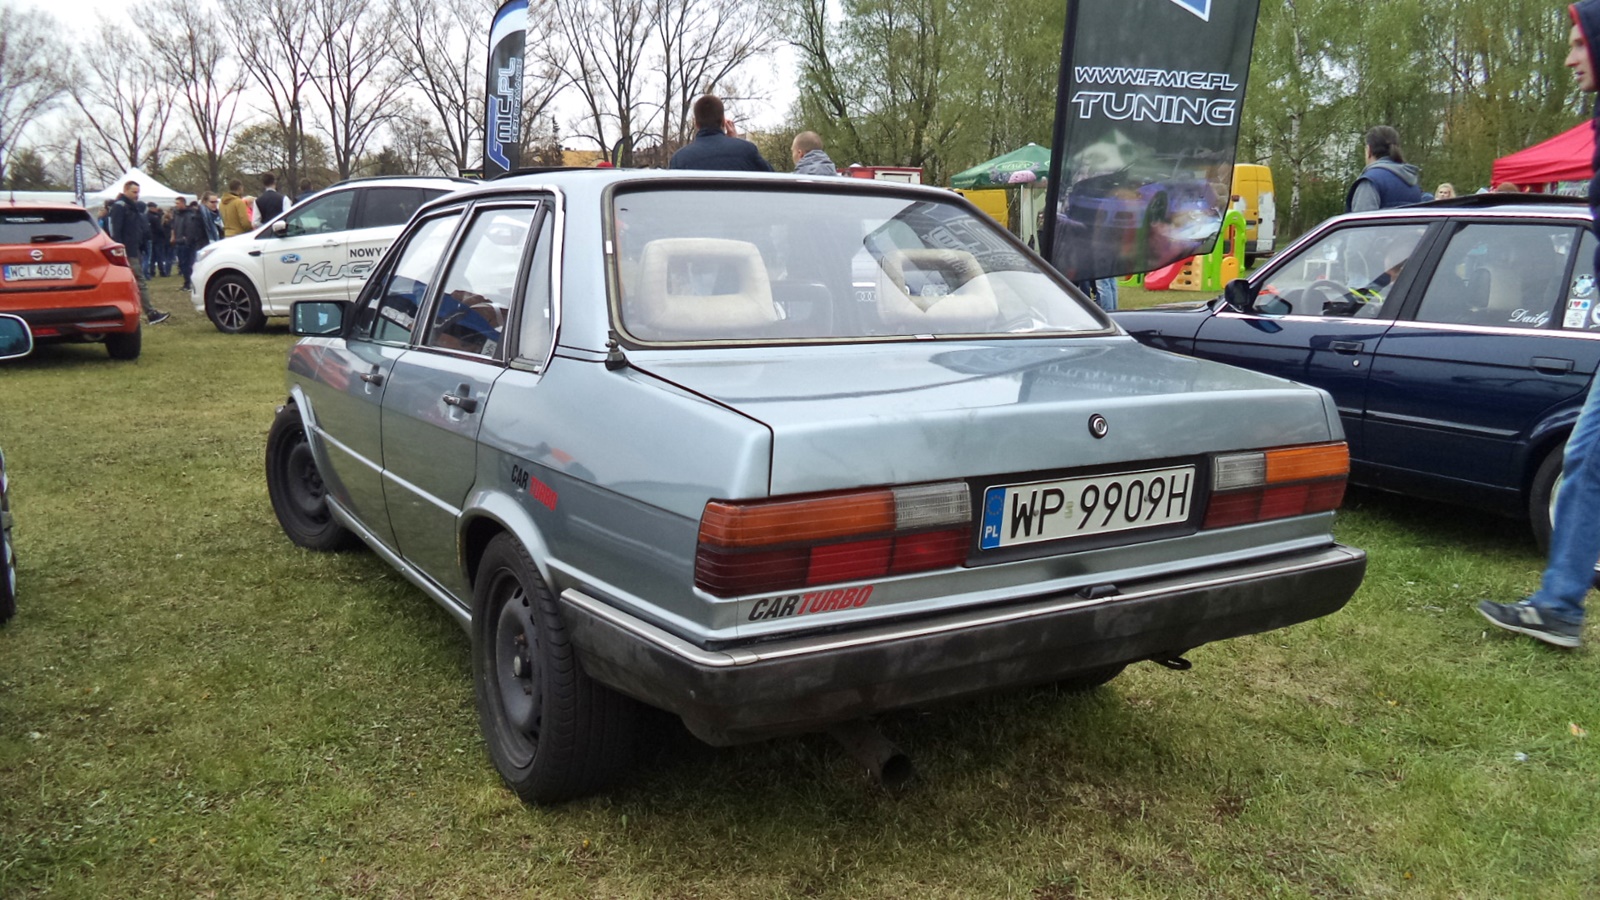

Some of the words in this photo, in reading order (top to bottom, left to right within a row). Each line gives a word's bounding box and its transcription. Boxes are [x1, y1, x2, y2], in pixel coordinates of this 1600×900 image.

[1075, 66, 1239, 92] WWW.FMIC.PL
[512, 58, 523, 143] PERFORMANCE
[1071, 91, 1237, 126] TUNING
[349, 247, 383, 258] NOWY
[10, 265, 31, 277] WCI
[36, 265, 70, 277] 46566
[1508, 308, 1550, 328] Daily
[1010, 487, 1065, 540] WP
[1077, 472, 1190, 531] 9909H
[984, 526, 999, 539] PL
